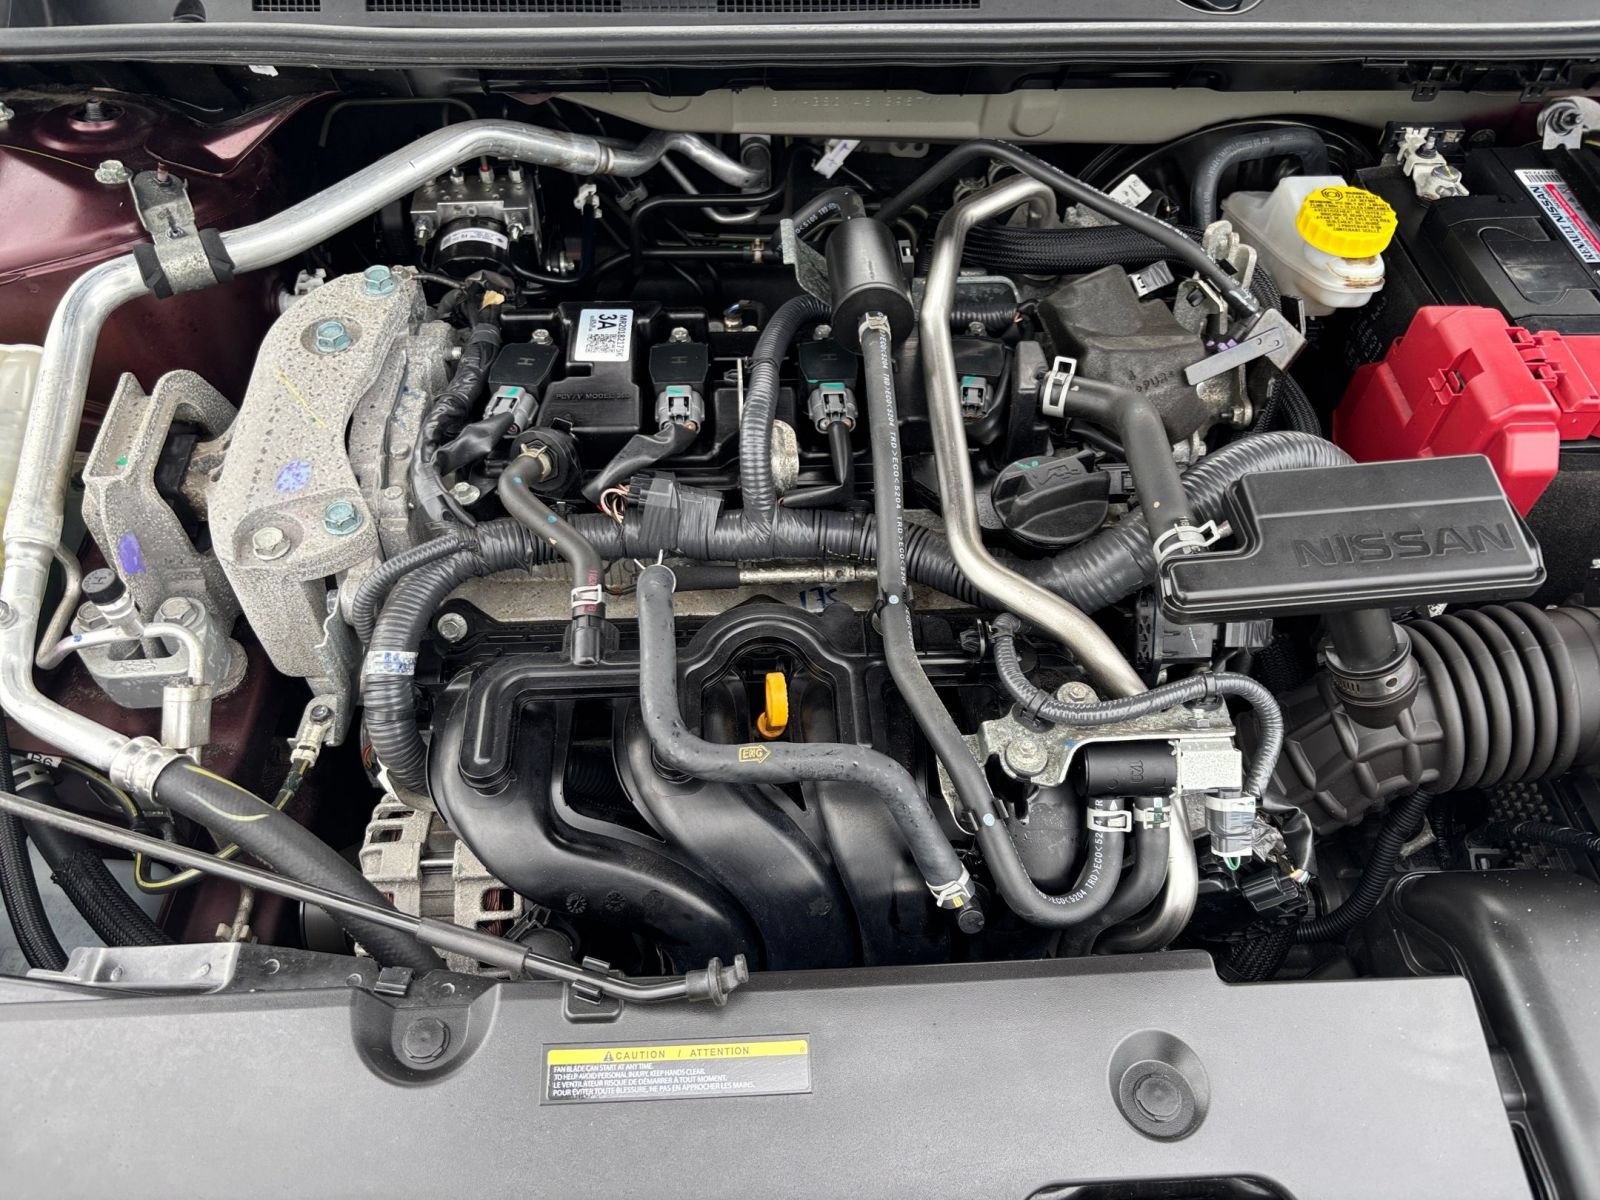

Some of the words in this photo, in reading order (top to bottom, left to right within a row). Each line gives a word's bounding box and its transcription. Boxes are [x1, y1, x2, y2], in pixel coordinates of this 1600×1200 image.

[1530, 185, 1567, 224] NISSAN
[1560, 224, 1597, 260] RENAULT
[597, 314, 618, 330] 3A
[1293, 522, 1517, 568] NISSAN
[742, 748, 763, 759] ENG
[615, 1050, 665, 1060] CAUTION
[689, 1046, 750, 1057] ATTENTION
[553, 1065, 566, 1073] FAN
[599, 1064, 617, 1072] START
[552, 1089, 571, 1097] POUR
[681, 1083, 720, 1091] APPROCHER
[553, 1081, 561, 1089] LE
[628, 1078, 638, 1086] DE
